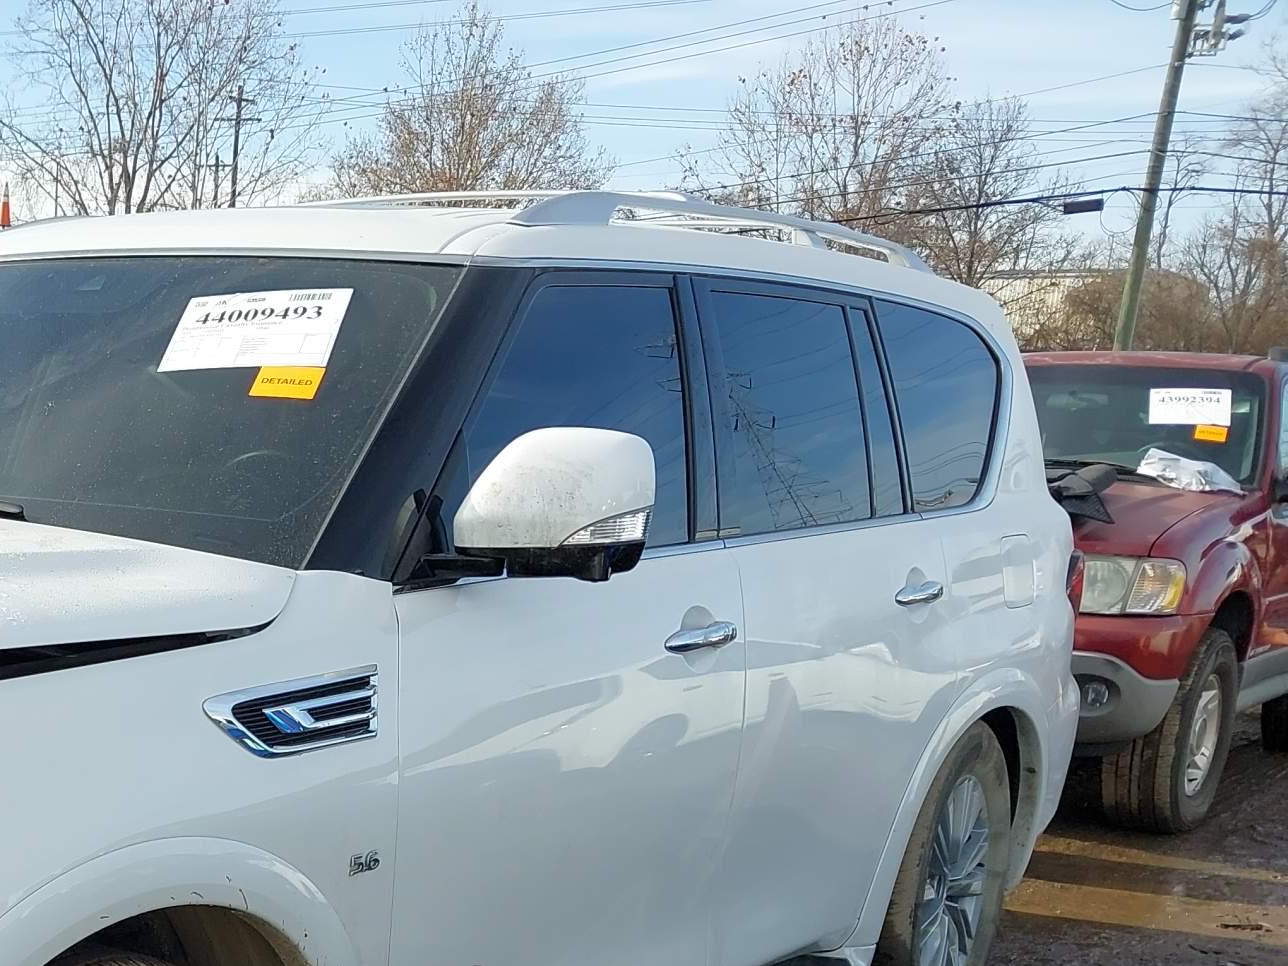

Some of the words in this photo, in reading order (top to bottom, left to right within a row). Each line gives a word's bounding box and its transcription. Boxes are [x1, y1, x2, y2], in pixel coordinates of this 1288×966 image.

[196, 305, 323, 325] 44009493
[261, 377, 313, 387] DETAILED
[1159, 396, 1221, 404] 43992394
